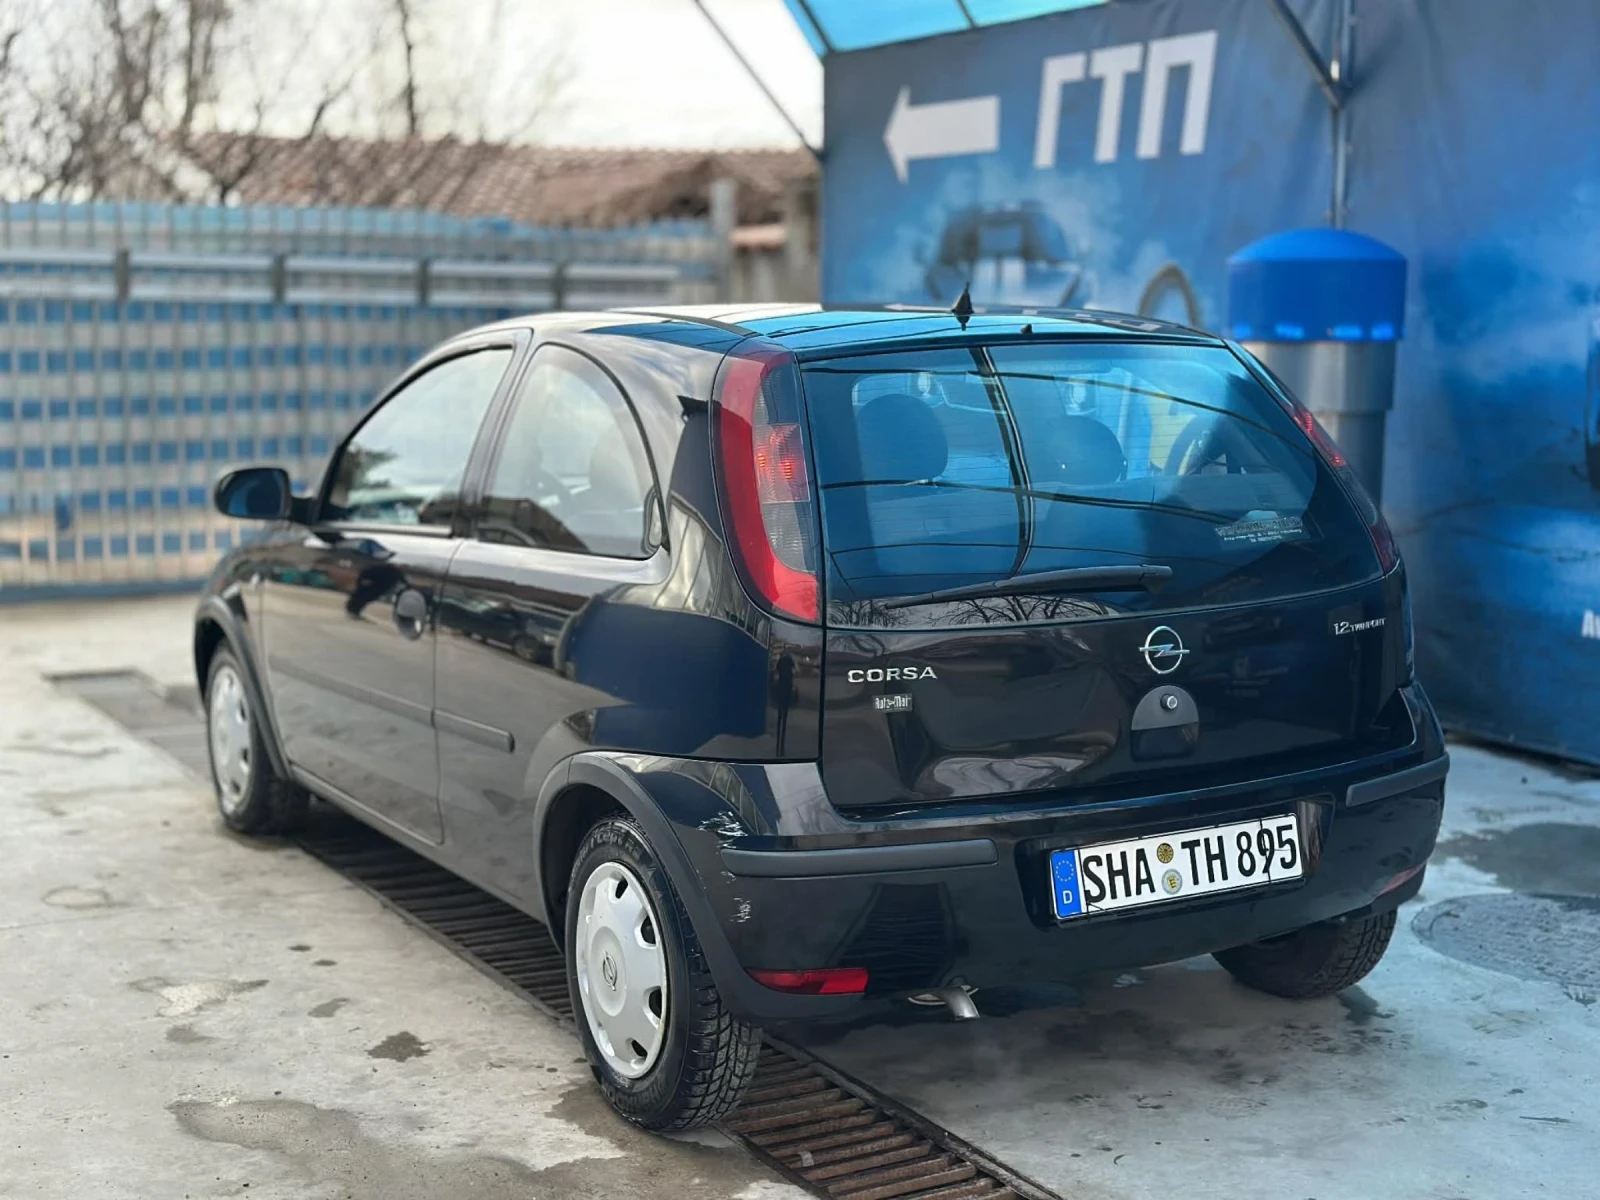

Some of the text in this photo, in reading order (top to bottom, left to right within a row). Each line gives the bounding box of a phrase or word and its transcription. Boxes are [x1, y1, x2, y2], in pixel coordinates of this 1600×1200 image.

[1033, 29, 1219, 169] ГТП
[847, 666, 938, 683] CORSA
[1082, 824, 1298, 905] SHA TH 895
[1063, 890, 1073, 905] D
